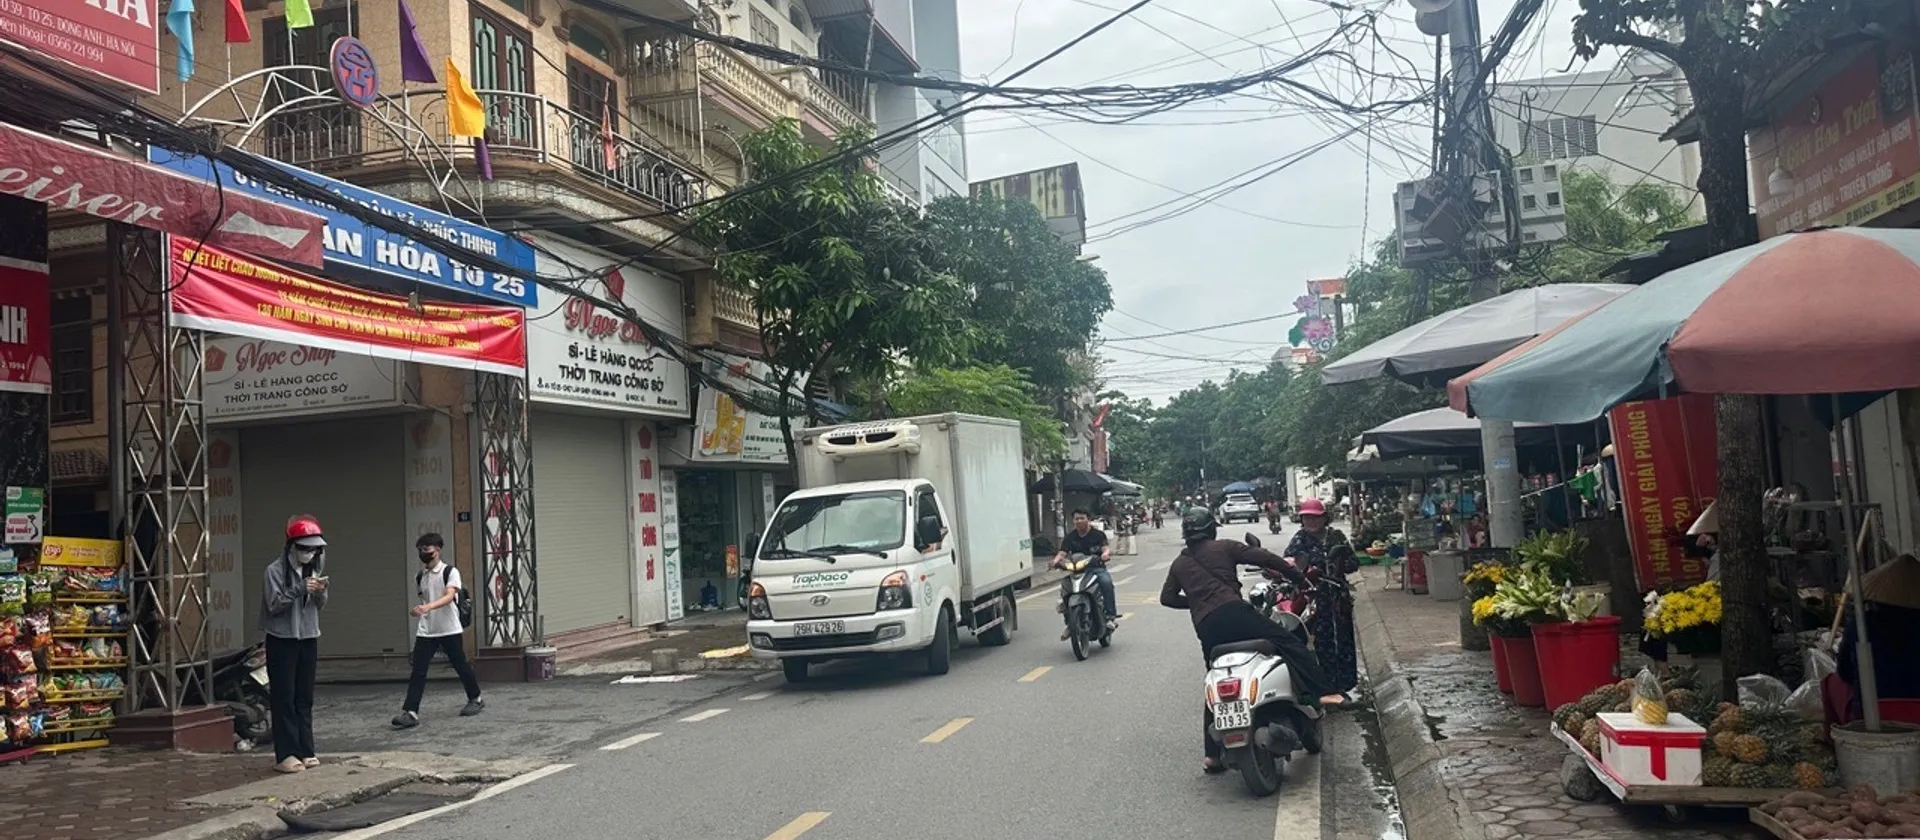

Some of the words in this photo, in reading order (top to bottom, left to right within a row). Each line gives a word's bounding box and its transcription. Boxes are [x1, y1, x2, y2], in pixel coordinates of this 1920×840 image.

[48, 33, 72, 52] 0366
[72, 41, 86, 57] 221
[1814, 122, 1840, 156] Hoa
[460, 231, 498, 258] THỊNH
[376, 240, 442, 278] HÓA
[493, 273, 525, 297] 25
[257, 303, 272, 317] 136
[564, 296, 618, 339] Ngọc
[235, 340, 287, 373] Ngọc
[600, 348, 627, 368] HÀNG
[628, 356, 654, 372] QCCC
[270, 373, 303, 387] HÀNG
[305, 371, 339, 385] QCCC
[559, 363, 586, 381] THỜI
[589, 369, 622, 387] TRANG
[624, 372, 650, 391] CÔNG
[254, 388, 293, 403] TRANG
[295, 383, 329, 398] CÔNG
[1627, 410, 1652, 461] PHÓNG
[1629, 464, 1659, 492] GIẢI
[408, 489, 451, 509] TRANG
[638, 493, 657, 512] TRANG
[1639, 496, 1666, 537] NGÀY
[641, 523, 657, 547] CÔNG
[1647, 537, 1672, 574] NĂM
[792, 572, 849, 585] Traphaco
